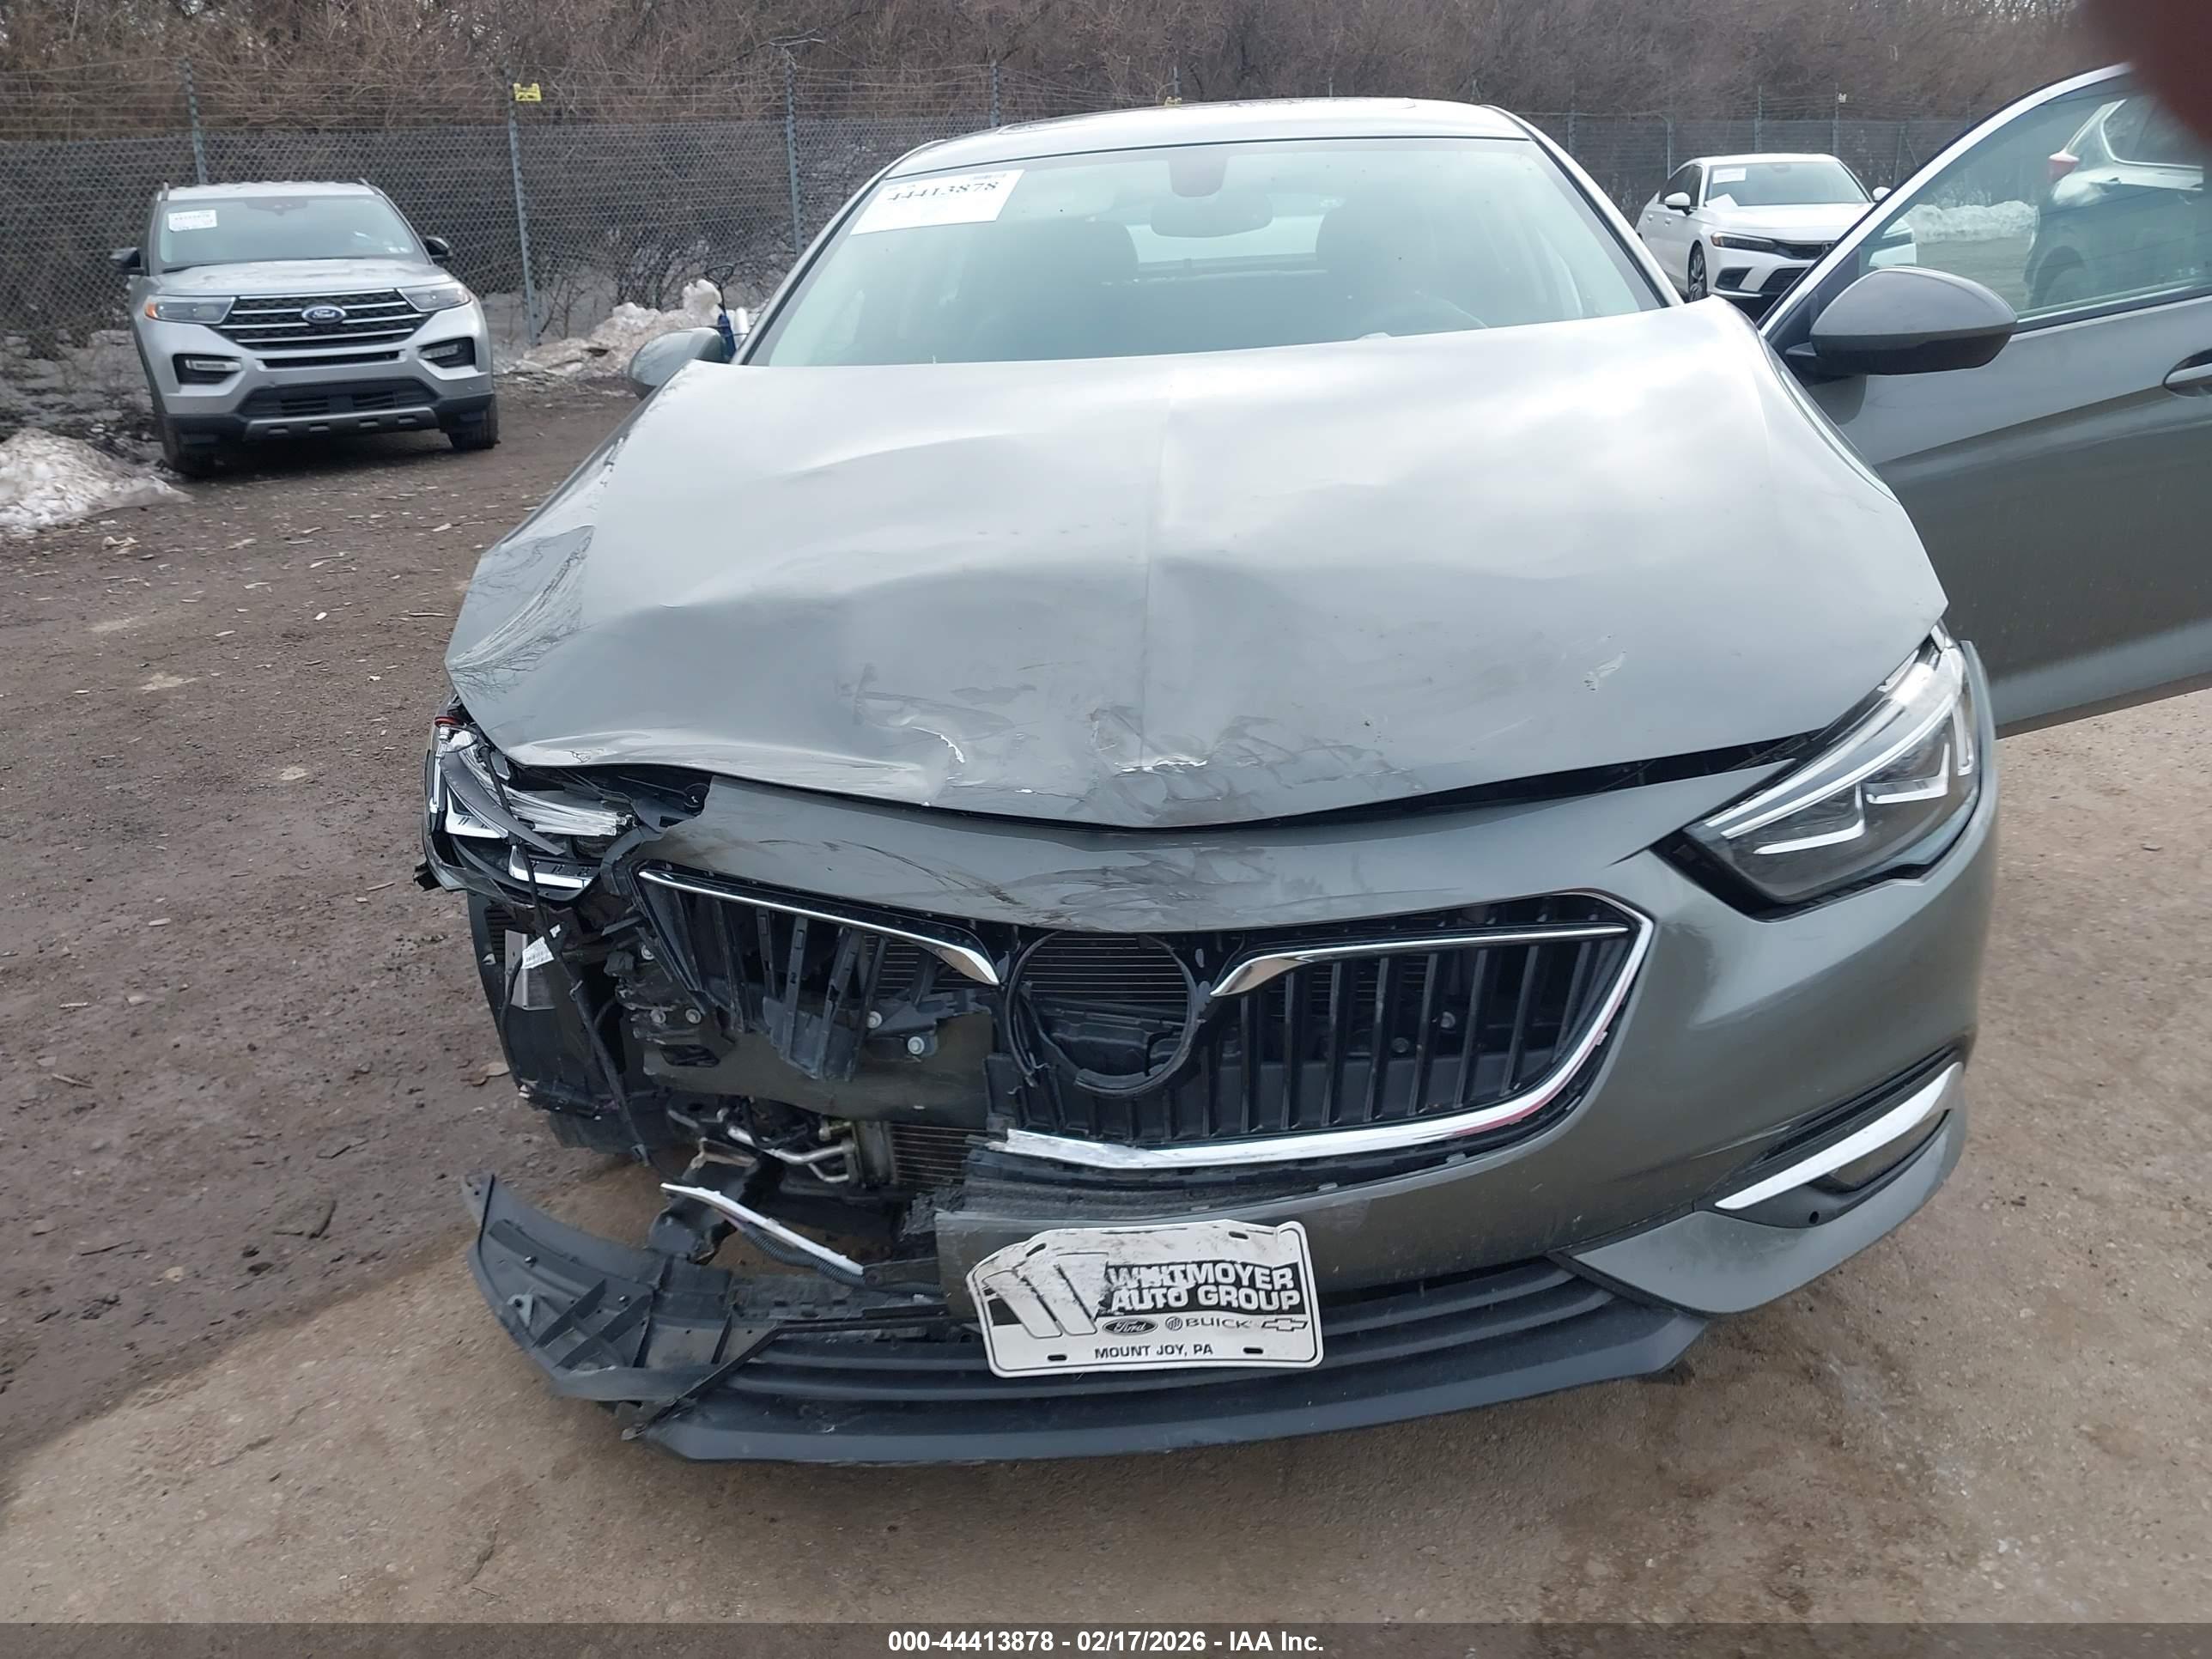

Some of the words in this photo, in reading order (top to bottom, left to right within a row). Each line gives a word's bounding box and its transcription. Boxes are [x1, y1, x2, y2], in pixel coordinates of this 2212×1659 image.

[1111, 1287, 1189, 1311] AUTO
[1197, 1285, 1302, 1311] GROUP
[1186, 1317, 1249, 1328] BUICK
[1095, 1345, 1151, 1359] MOUNT
[1156, 1344, 1188, 1357] JOY,
[1193, 1343, 1213, 1355] PA
